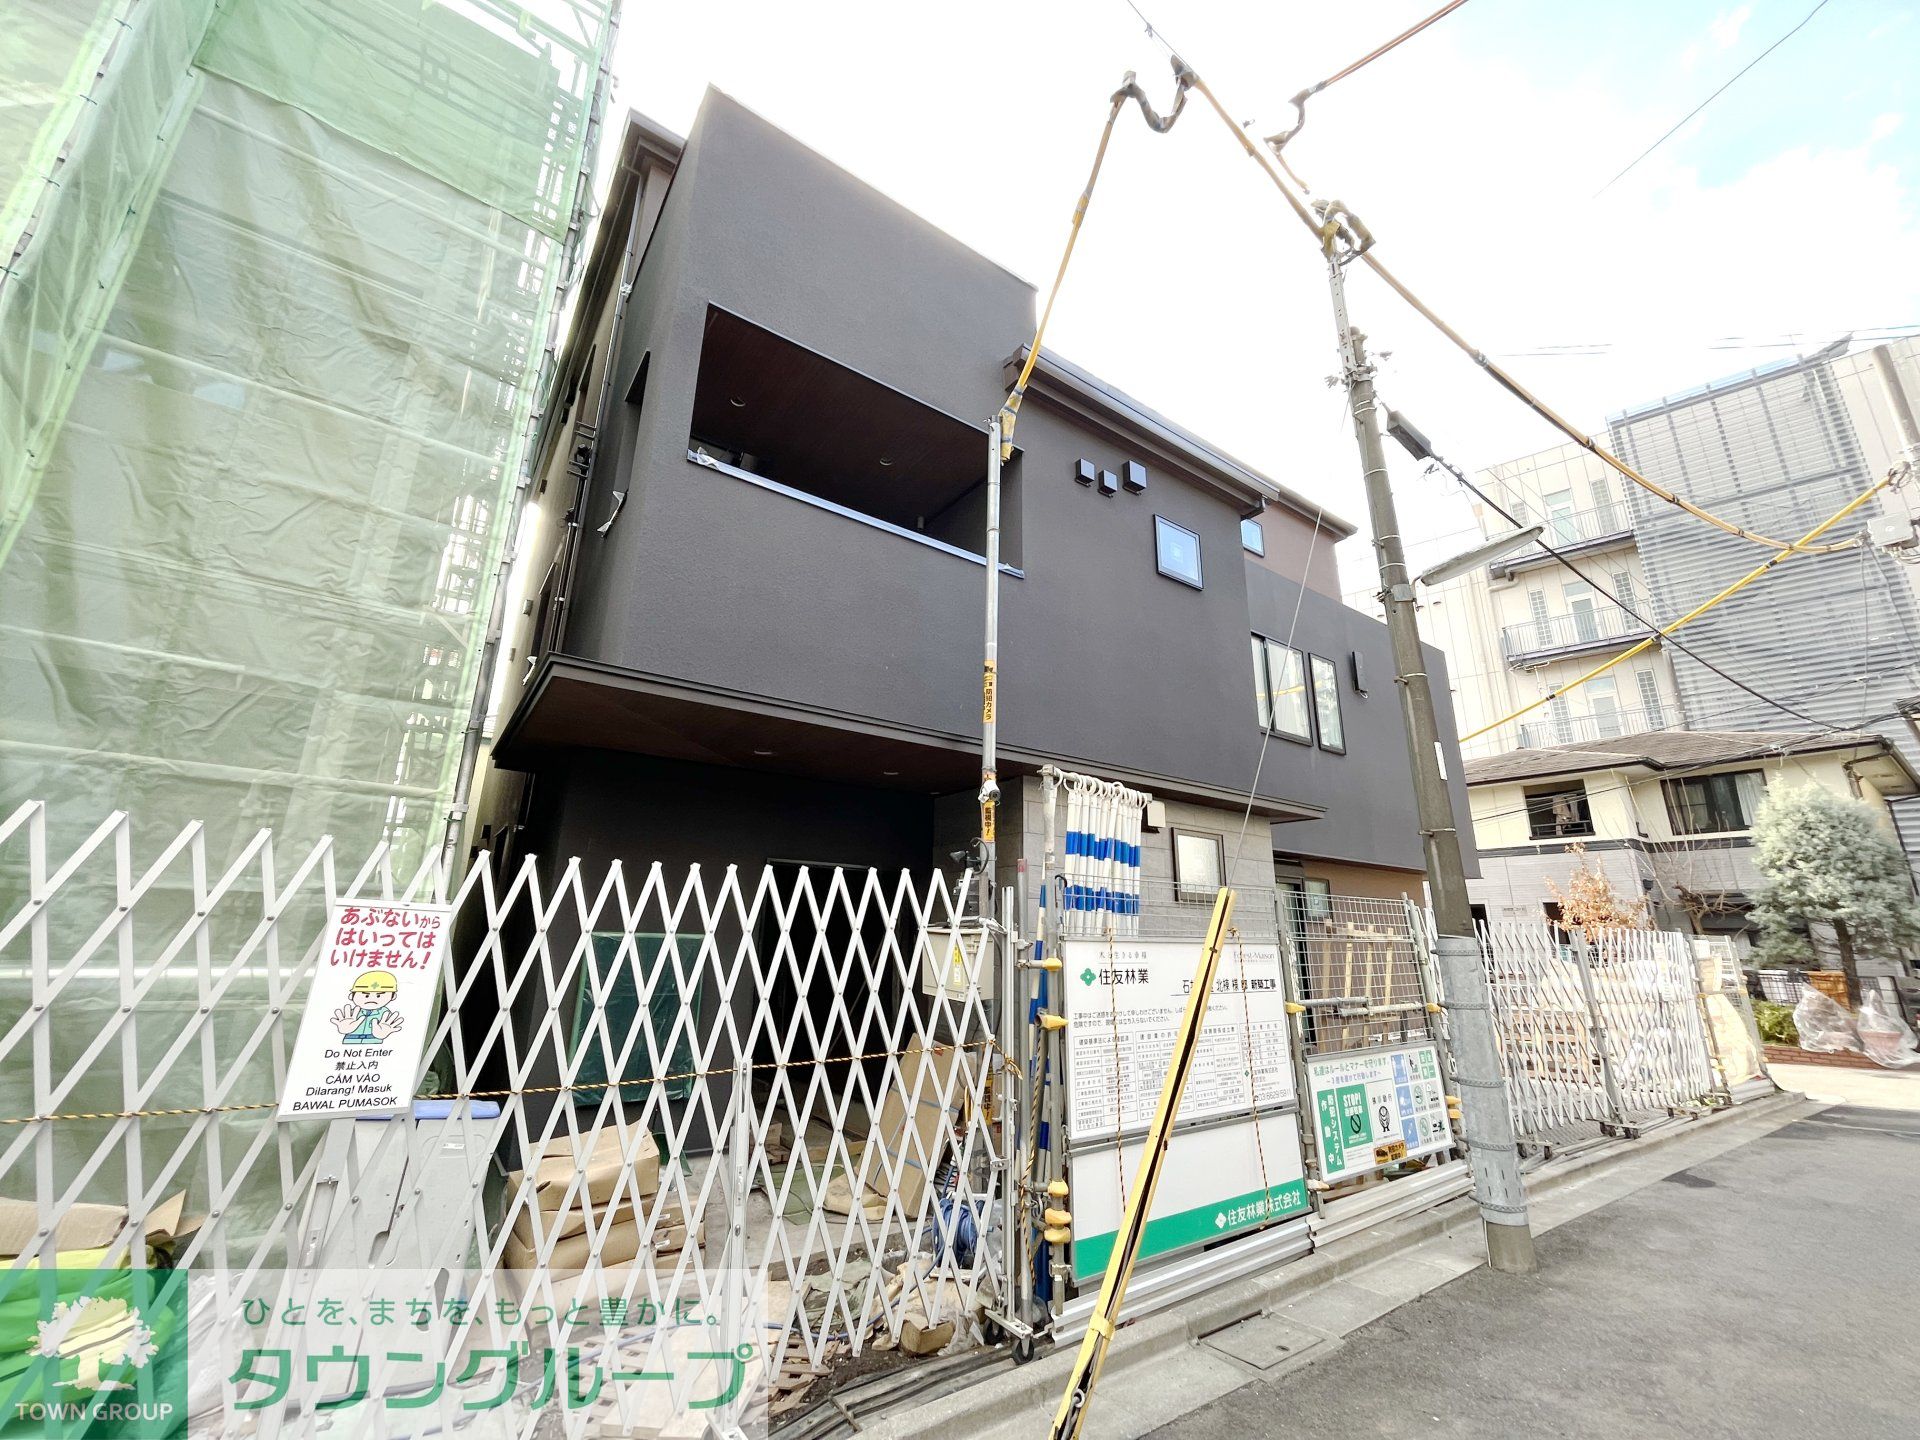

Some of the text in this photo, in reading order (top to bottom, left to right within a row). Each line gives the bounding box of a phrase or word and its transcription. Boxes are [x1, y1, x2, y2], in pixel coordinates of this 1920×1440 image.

[340, 907, 441, 929] あぶないから
[335, 927, 436, 949] はいっては
[1098, 968, 1149, 986] 住友林業
[324, 1048, 393, 1059] Do Not Enter
[334, 1060, 379, 1071] 禁止入内
[305, 1083, 392, 1097] Dilarang! Masuk
[292, 1096, 398, 1111] BAWAL PUMASOK
[1227, 1188, 1302, 1226] 住友林業株式会社
